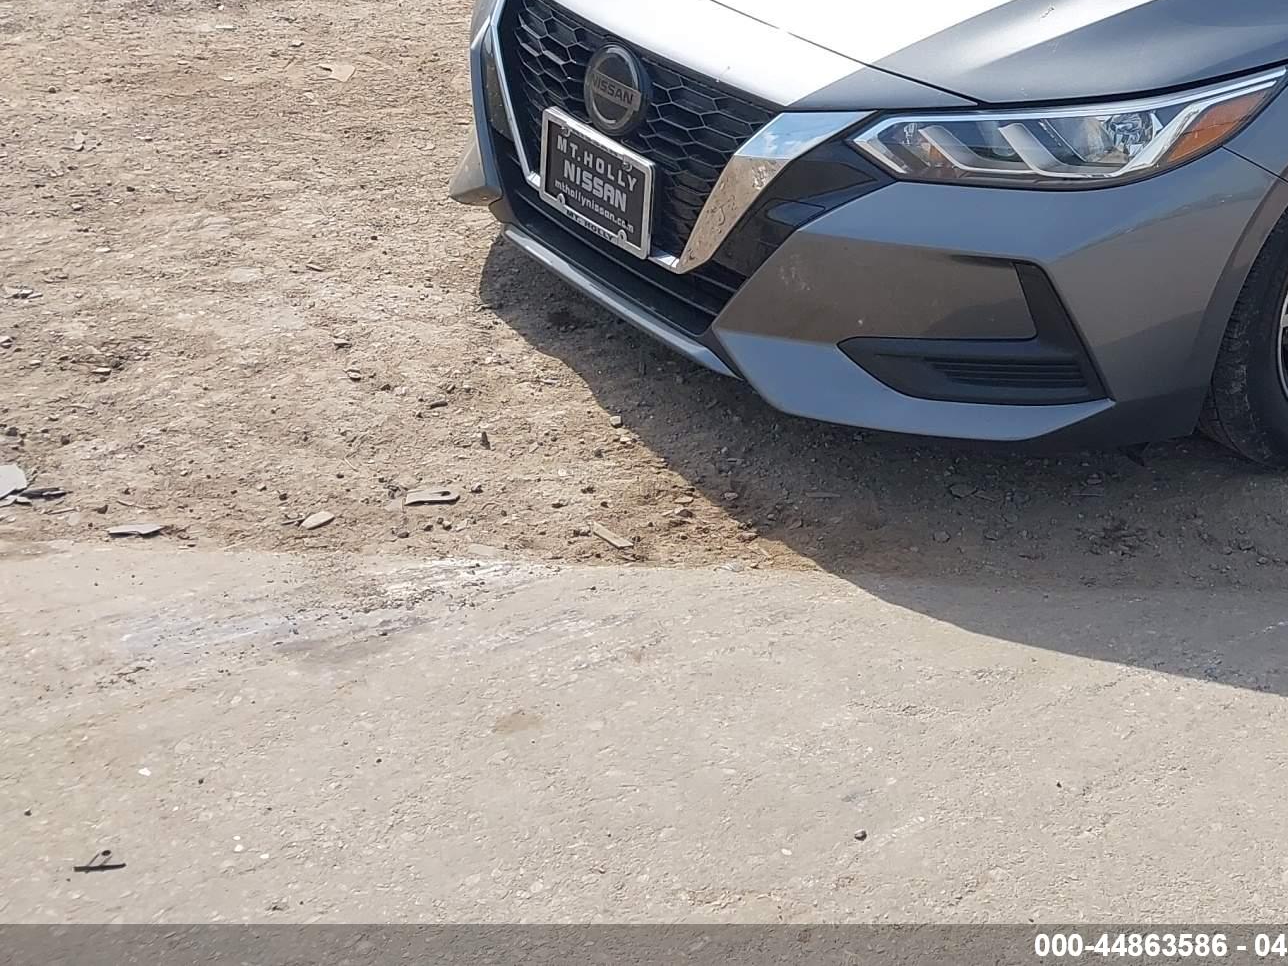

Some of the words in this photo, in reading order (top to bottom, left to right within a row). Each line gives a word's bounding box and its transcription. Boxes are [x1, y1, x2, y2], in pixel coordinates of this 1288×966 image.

[591, 74, 634, 105] NISSAN
[554, 179, 634, 234] mthollynissan.com
[563, 160, 627, 213] NISSAN
